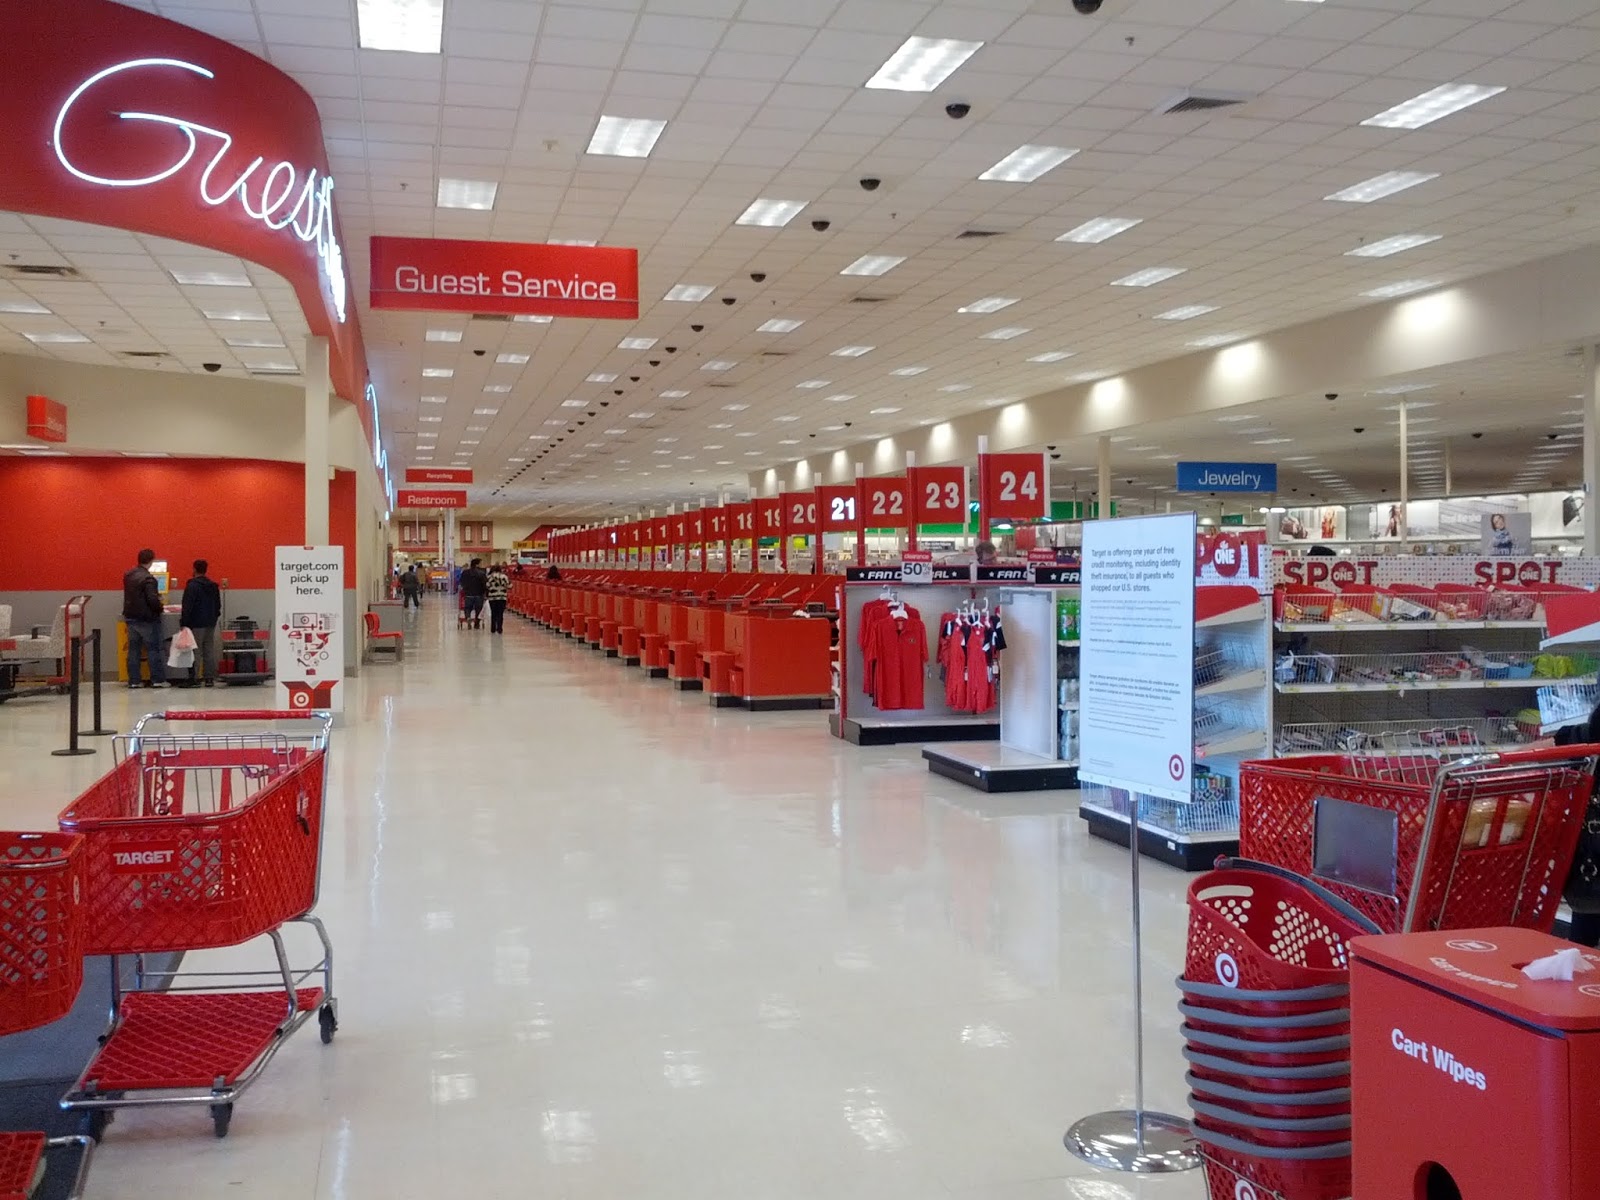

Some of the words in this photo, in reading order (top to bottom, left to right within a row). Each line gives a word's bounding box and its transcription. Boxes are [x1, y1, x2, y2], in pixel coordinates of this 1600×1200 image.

[53, 58, 334, 257] Guest
[395, 266, 491, 296] Guest
[501, 270, 616, 300] Service
[1000, 470, 1038, 500] 24
[1198, 470, 1261, 490] Jewelry
[408, 495, 457, 504] Restroom
[872, 491, 903, 514] 22
[926, 482, 960, 509] 23
[793, 504, 816, 524] 20
[831, 497, 855, 520] 21
[1092, 550, 1106, 558] Target
[1214, 548, 1236, 564] ONE
[281, 562, 338, 572] target.com
[868, 571, 892, 579] FAN
[1284, 561, 1378, 588] SPOT
[1333, 571, 1353, 581] ONE
[1475, 561, 1562, 587] SPOT
[1520, 571, 1539, 580] ONE
[290, 574, 312, 584] pick
[316, 575, 329, 584] up
[1060, 572, 1080, 581] FA
[296, 586, 323, 595] here.
[113, 850, 174, 865] TARGET
[1392, 1028, 1428, 1064] Cart
[1432, 1045, 1487, 1090] Wipes
